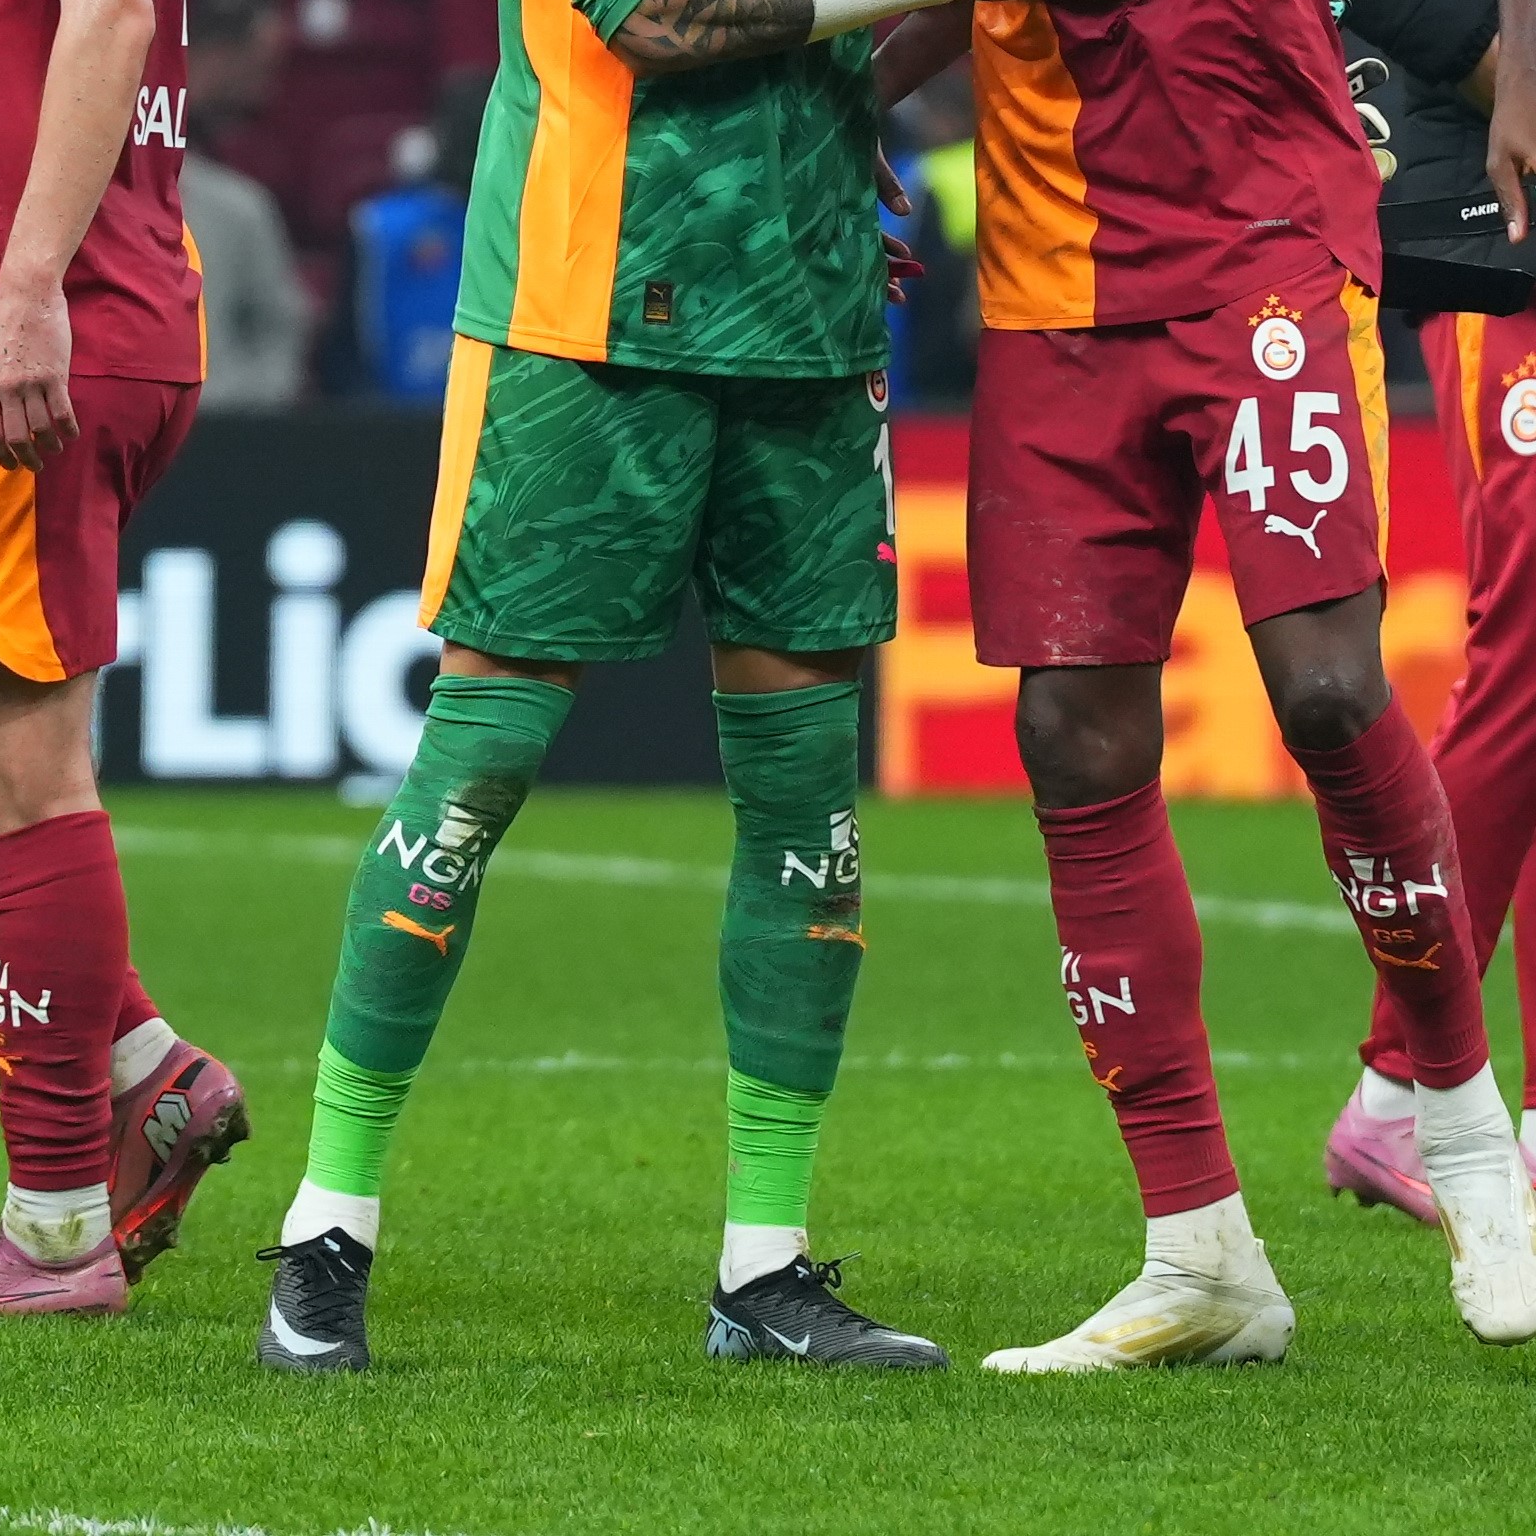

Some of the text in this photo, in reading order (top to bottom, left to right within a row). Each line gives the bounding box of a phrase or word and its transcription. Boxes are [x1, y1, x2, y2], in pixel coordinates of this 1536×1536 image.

[133, 85, 187, 148] SAL
[873, 422, 896, 536] 1
[1225, 391, 1350, 513] 45
[781, 846, 860, 889] NG
[1066, 976, 1137, 1026] GN
